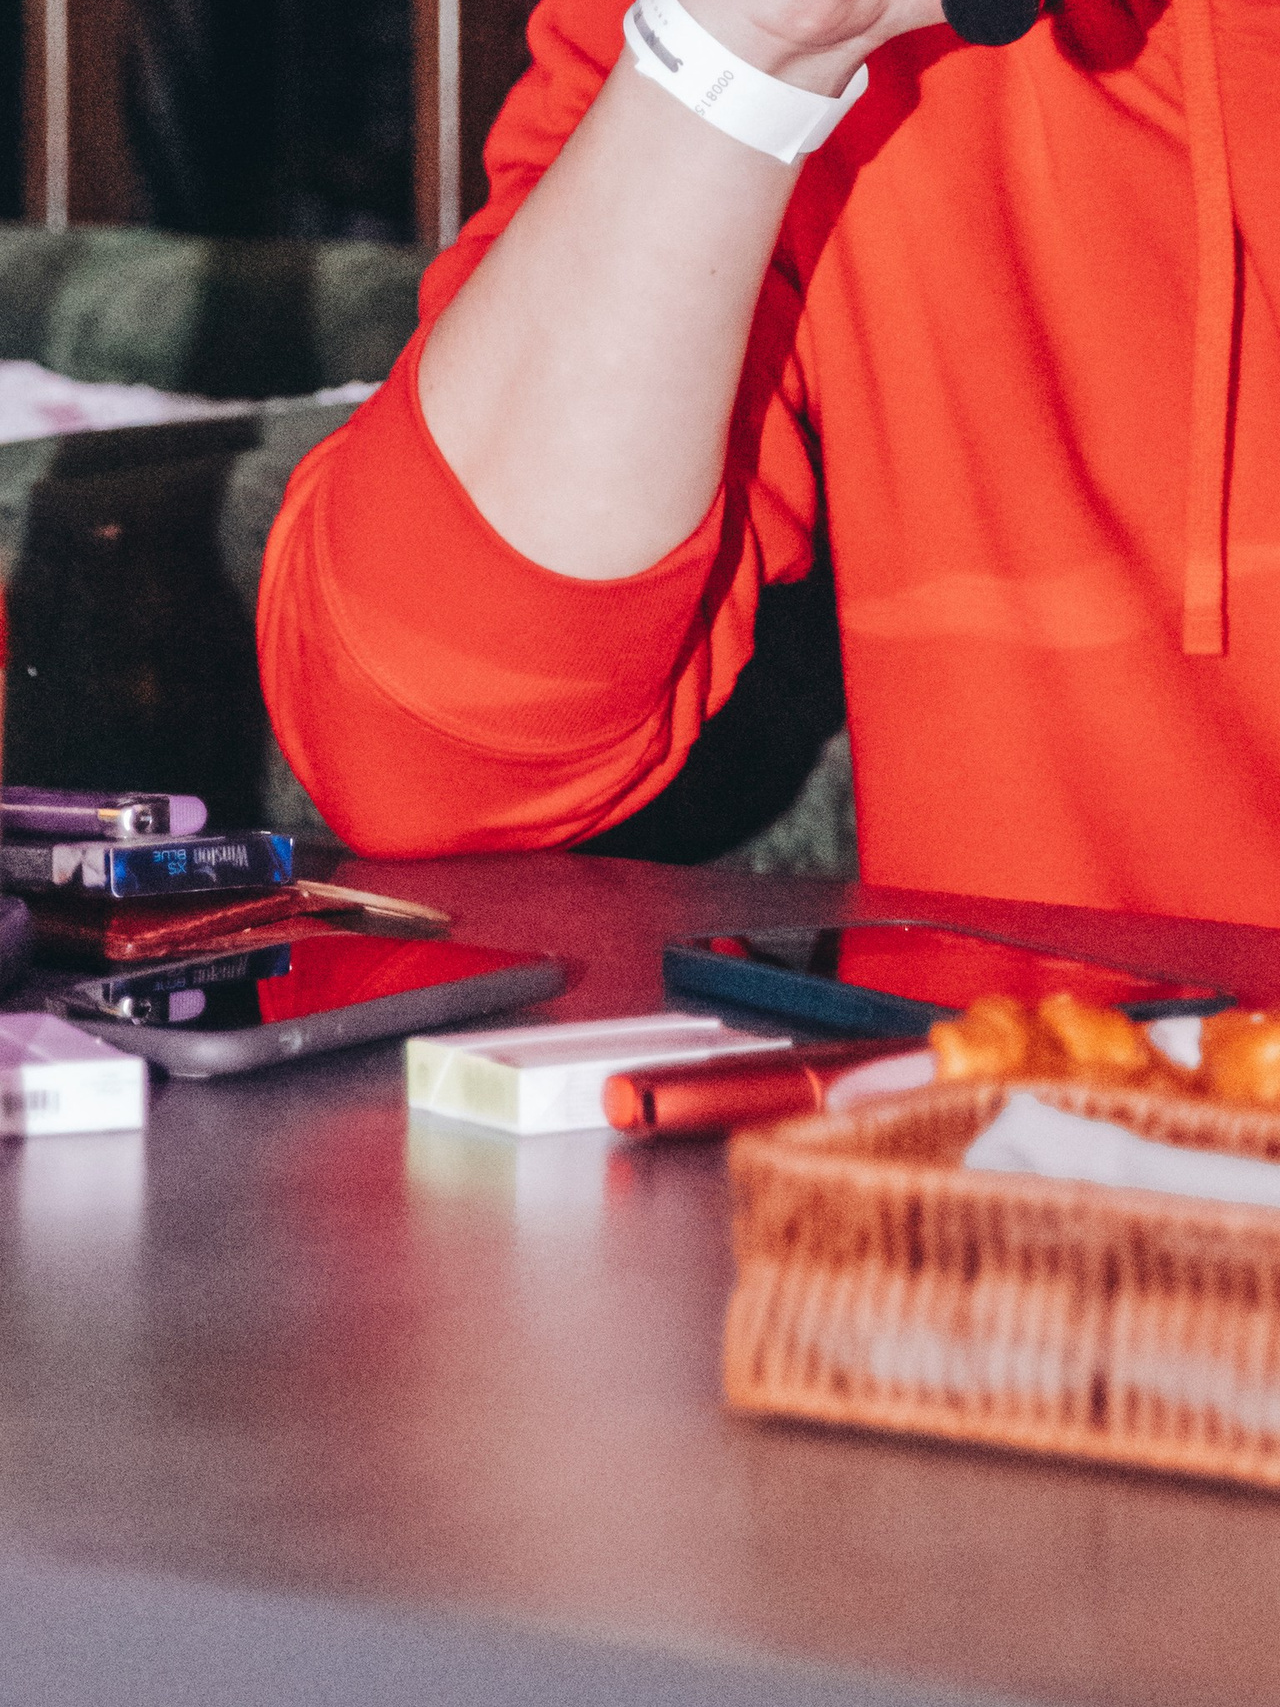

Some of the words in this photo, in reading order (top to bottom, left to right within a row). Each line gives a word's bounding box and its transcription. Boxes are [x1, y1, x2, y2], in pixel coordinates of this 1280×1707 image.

[695, 70, 735, 116] 000815
[152, 849, 187, 864] BLUE
[192, 844, 249, 868] Winston
[167, 863, 188, 876] XS
